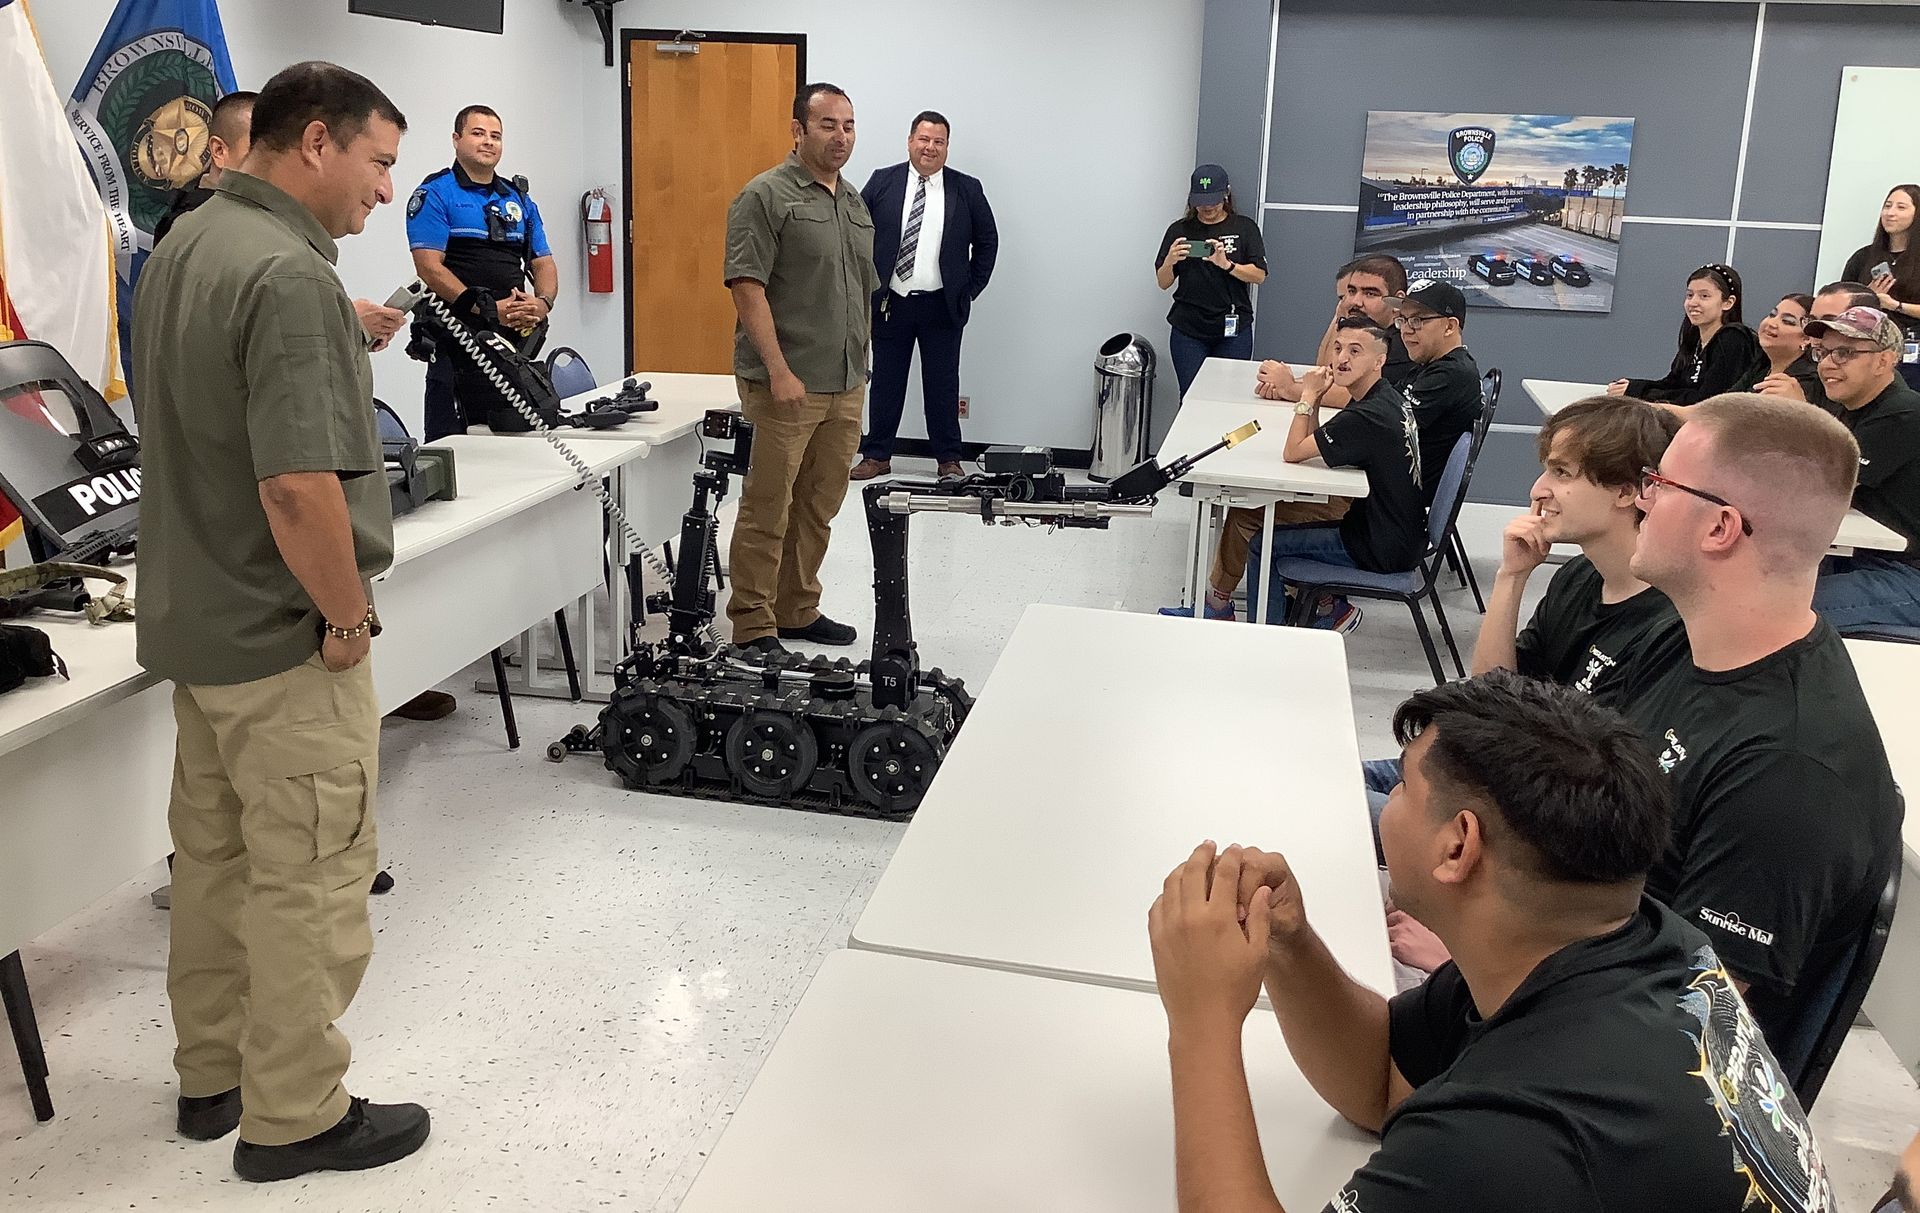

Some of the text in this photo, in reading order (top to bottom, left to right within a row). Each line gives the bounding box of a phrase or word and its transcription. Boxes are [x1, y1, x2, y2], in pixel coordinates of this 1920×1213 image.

[1455, 129, 1492, 140] BROWNSVILLE
[1463, 135, 1484, 143] POLICE
[71, 109, 130, 251] SERVICE FROM THE HEART
[1399, 191, 1441, 201] Brownsville
[1442, 191, 1461, 199] Police
[1461, 190, 1497, 199] Department,
[1497, 188, 1510, 196] with
[1393, 201, 1431, 211] leadership
[1431, 199, 1469, 210] philosophy,
[1469, 198, 1481, 206] will
[1506, 197, 1524, 205] protect
[1415, 208, 1455, 221] partnership
[1455, 207, 1469, 216] with
[1469, 207, 1480, 215] the
[1405, 267, 1467, 281] Leadership
[67, 467, 141, 516] POLIC
[882, 676, 897, 687] T5
[1699, 906, 1746, 936] Sunrise
